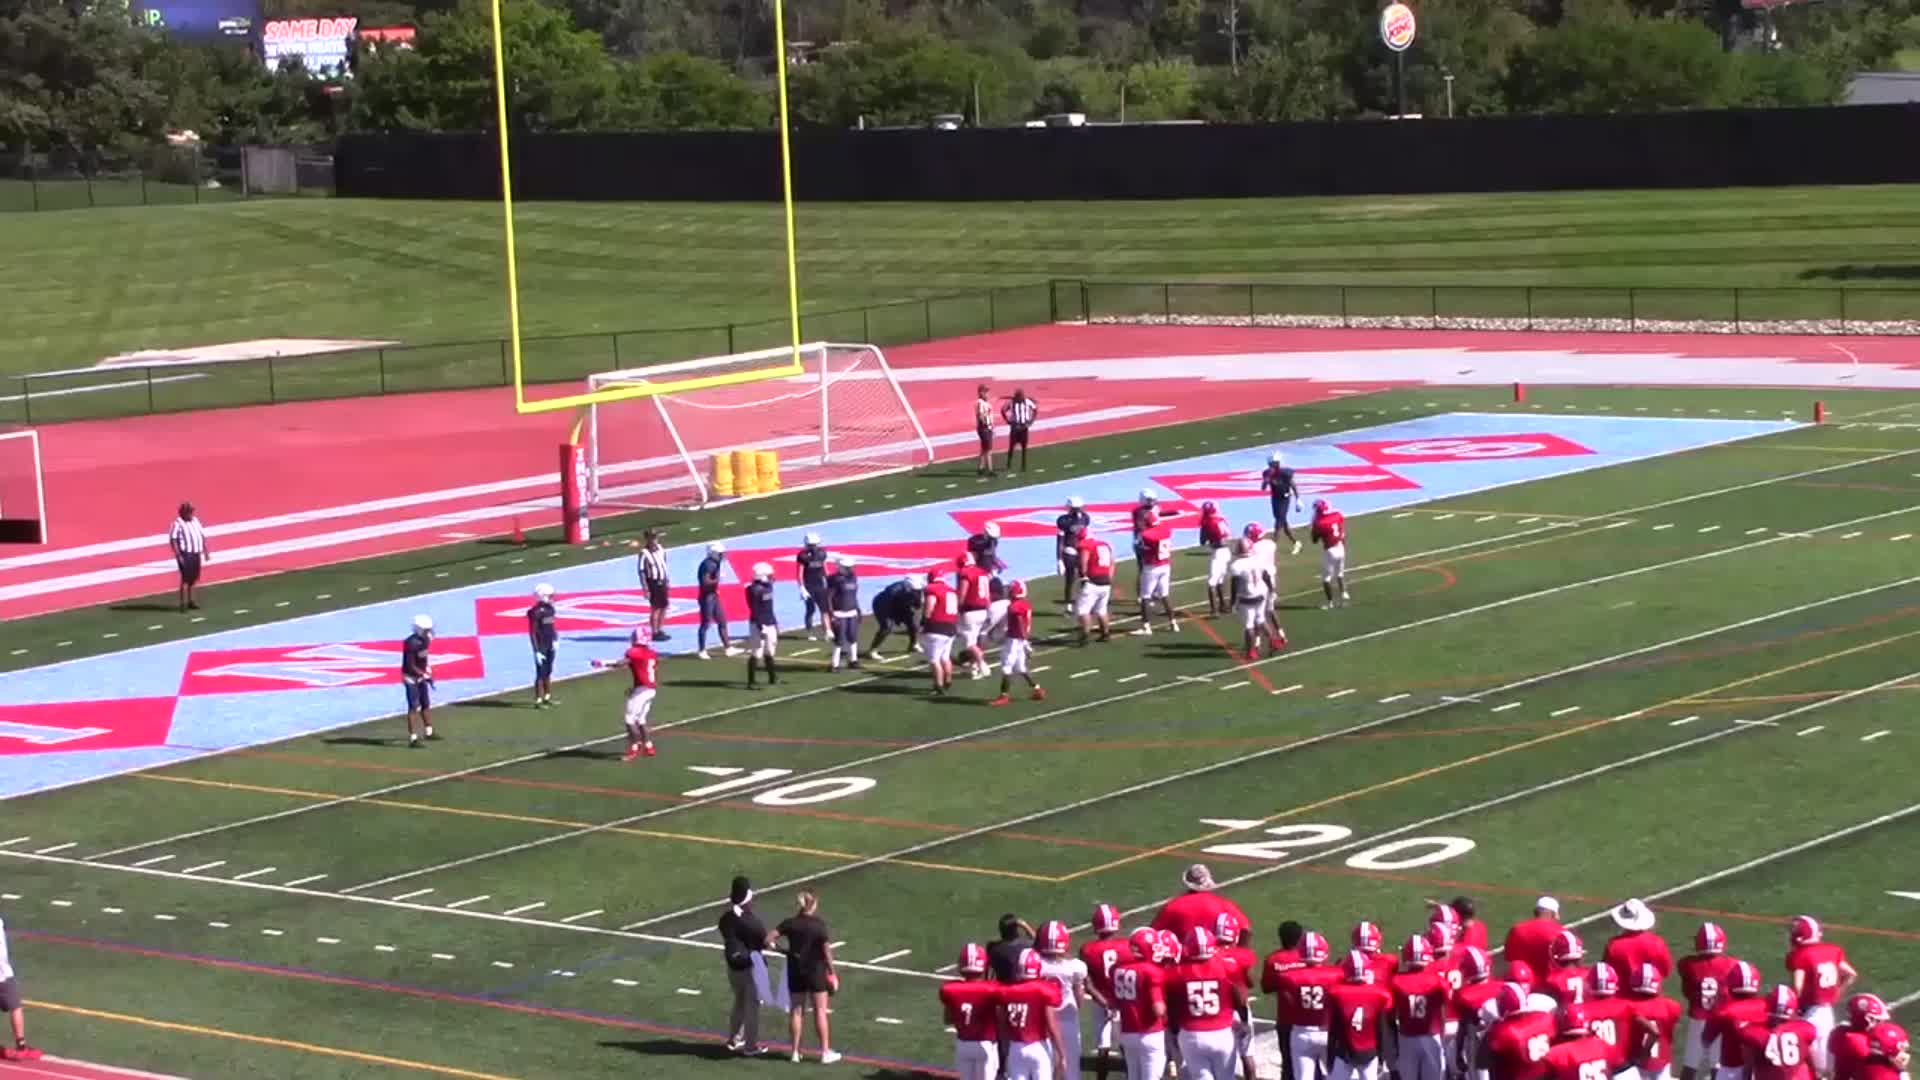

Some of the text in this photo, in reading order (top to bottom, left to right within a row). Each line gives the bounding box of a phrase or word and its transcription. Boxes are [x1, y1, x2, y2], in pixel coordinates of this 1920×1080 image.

[264, 20, 317, 41] SAME
[319, 17, 357, 39] DAY
[682, 767, 877, 805] 10
[1201, 824, 1476, 869] 20
[1187, 981, 1221, 1016] 55
[1300, 986, 1324, 1009] 52
[1567, 977, 1583, 1004] 7
[961, 1003, 973, 1025] 7
[1007, 1003, 1028, 1028] 27
[1351, 1007, 1364, 1032] 4
[1765, 1032, 1800, 1067] 46
